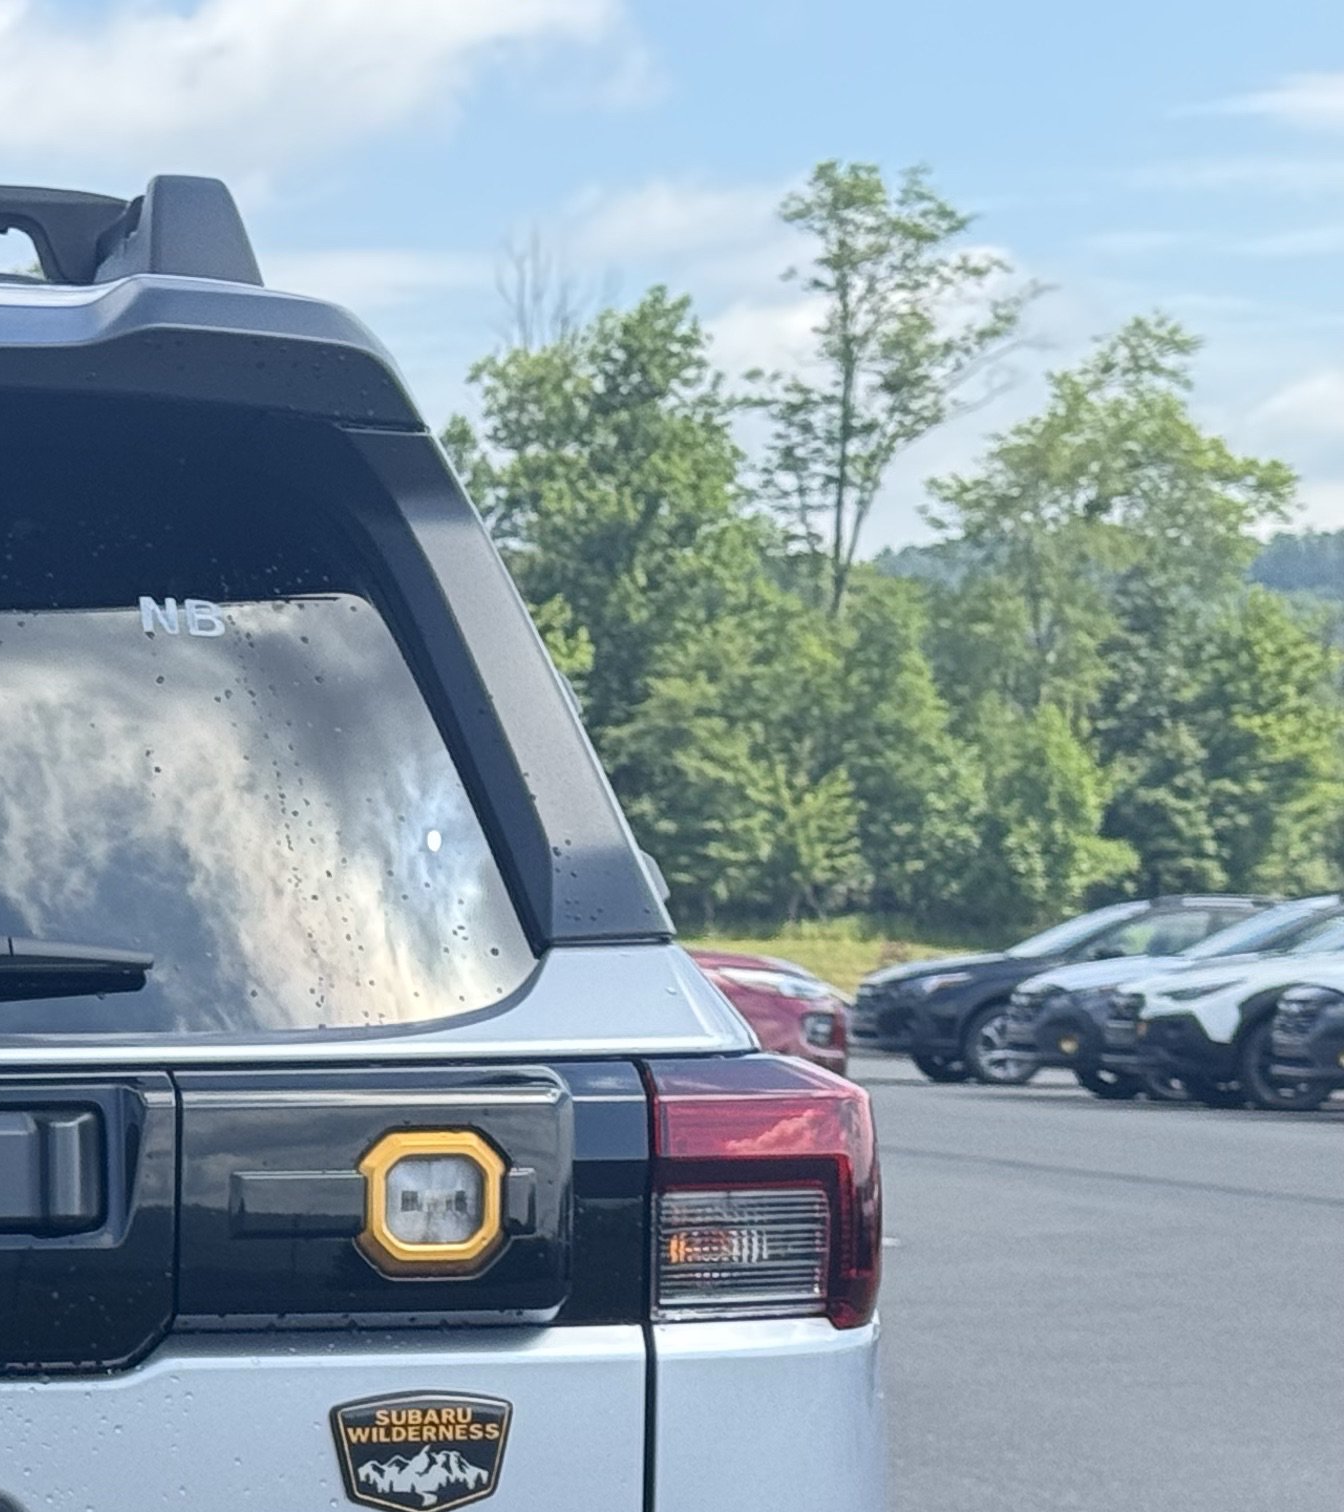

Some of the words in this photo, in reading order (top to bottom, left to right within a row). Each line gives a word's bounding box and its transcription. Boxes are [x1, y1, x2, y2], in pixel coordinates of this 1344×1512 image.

[139, 596, 226, 637] NB
[375, 1408, 472, 1426] SUBARU
[347, 1424, 500, 1443] WILDERNESS
